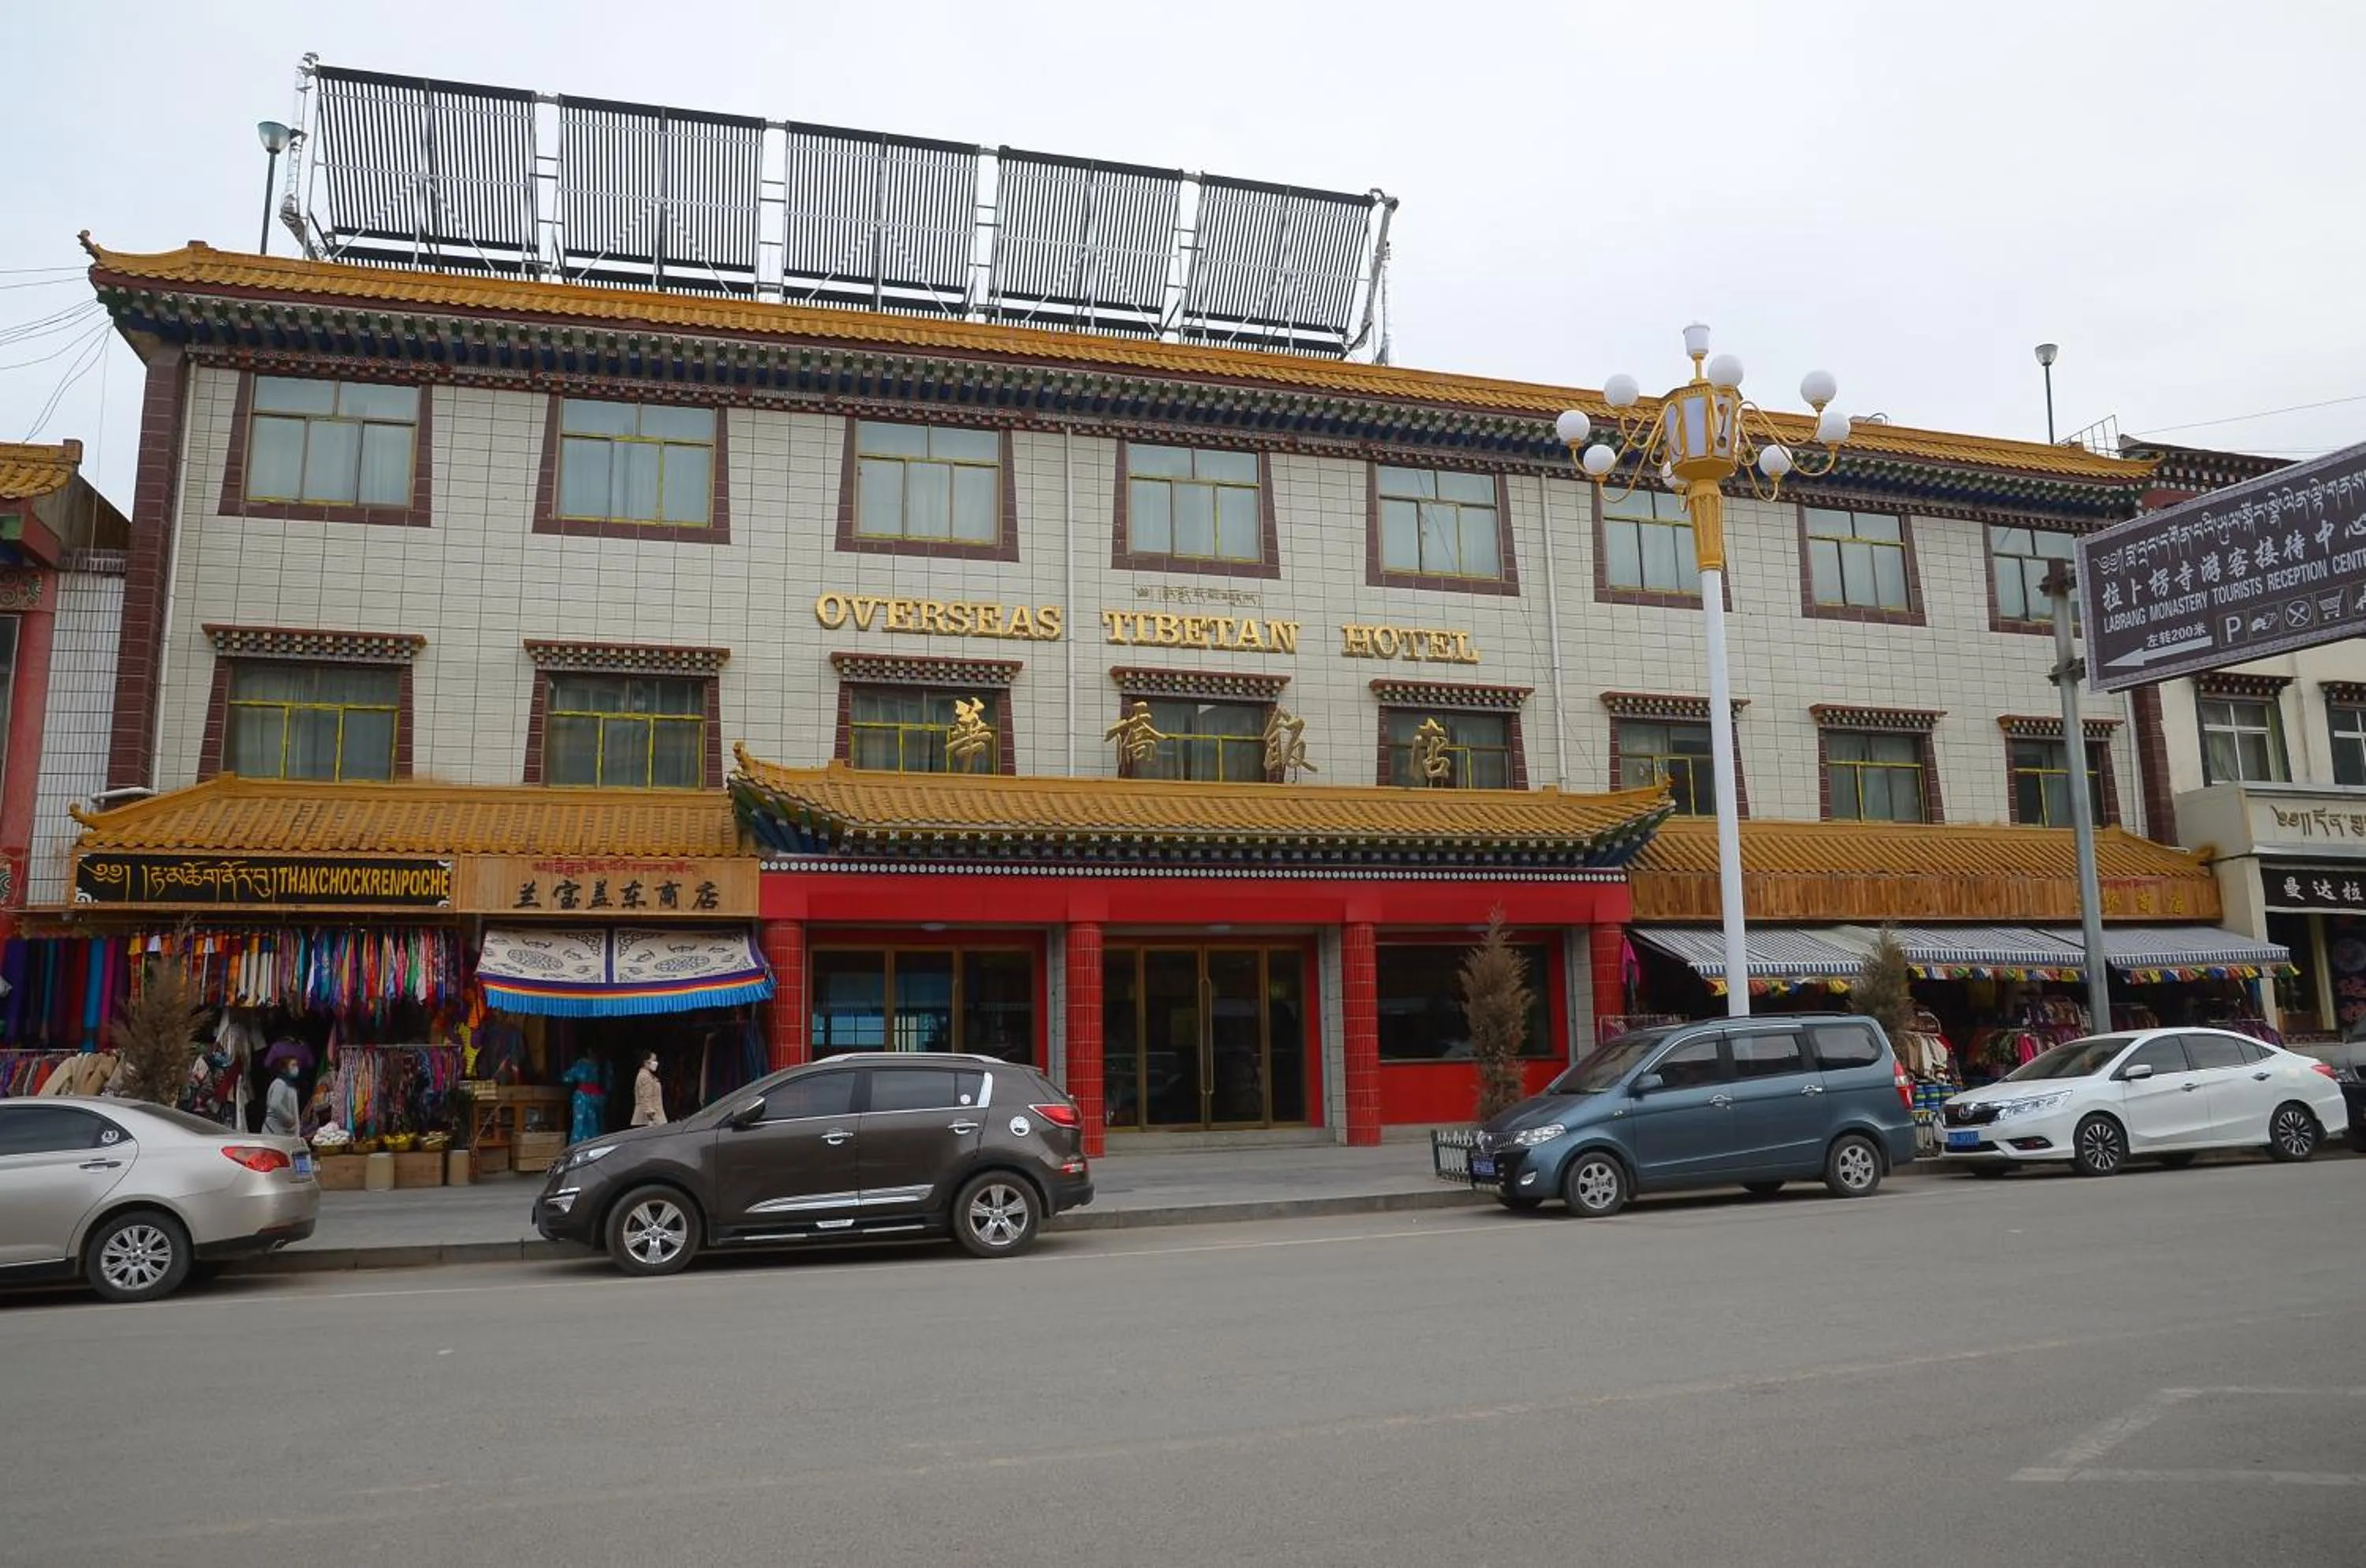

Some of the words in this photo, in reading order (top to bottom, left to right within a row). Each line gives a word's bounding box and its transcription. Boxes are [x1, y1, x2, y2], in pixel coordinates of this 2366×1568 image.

[2102, 513, 2366, 612] 拉卜楞寺游客接待中心
[2103, 607, 2146, 633] LABRANG
[2149, 591, 2208, 622] MONASTERY
[2211, 577, 2263, 606] TOURISTS
[2266, 558, 2328, 592] RECEPTION
[815, 593, 1062, 641] OVERSEAS
[1102, 610, 1300, 654] TIBETAN
[1341, 623, 1481, 664] HOTEL
[2146, 622, 2207, 648] 左转200米
[278, 866, 449, 897] THAKCHOCKRENPOCHE
[2283, 875, 2364, 902] 曼达拉
